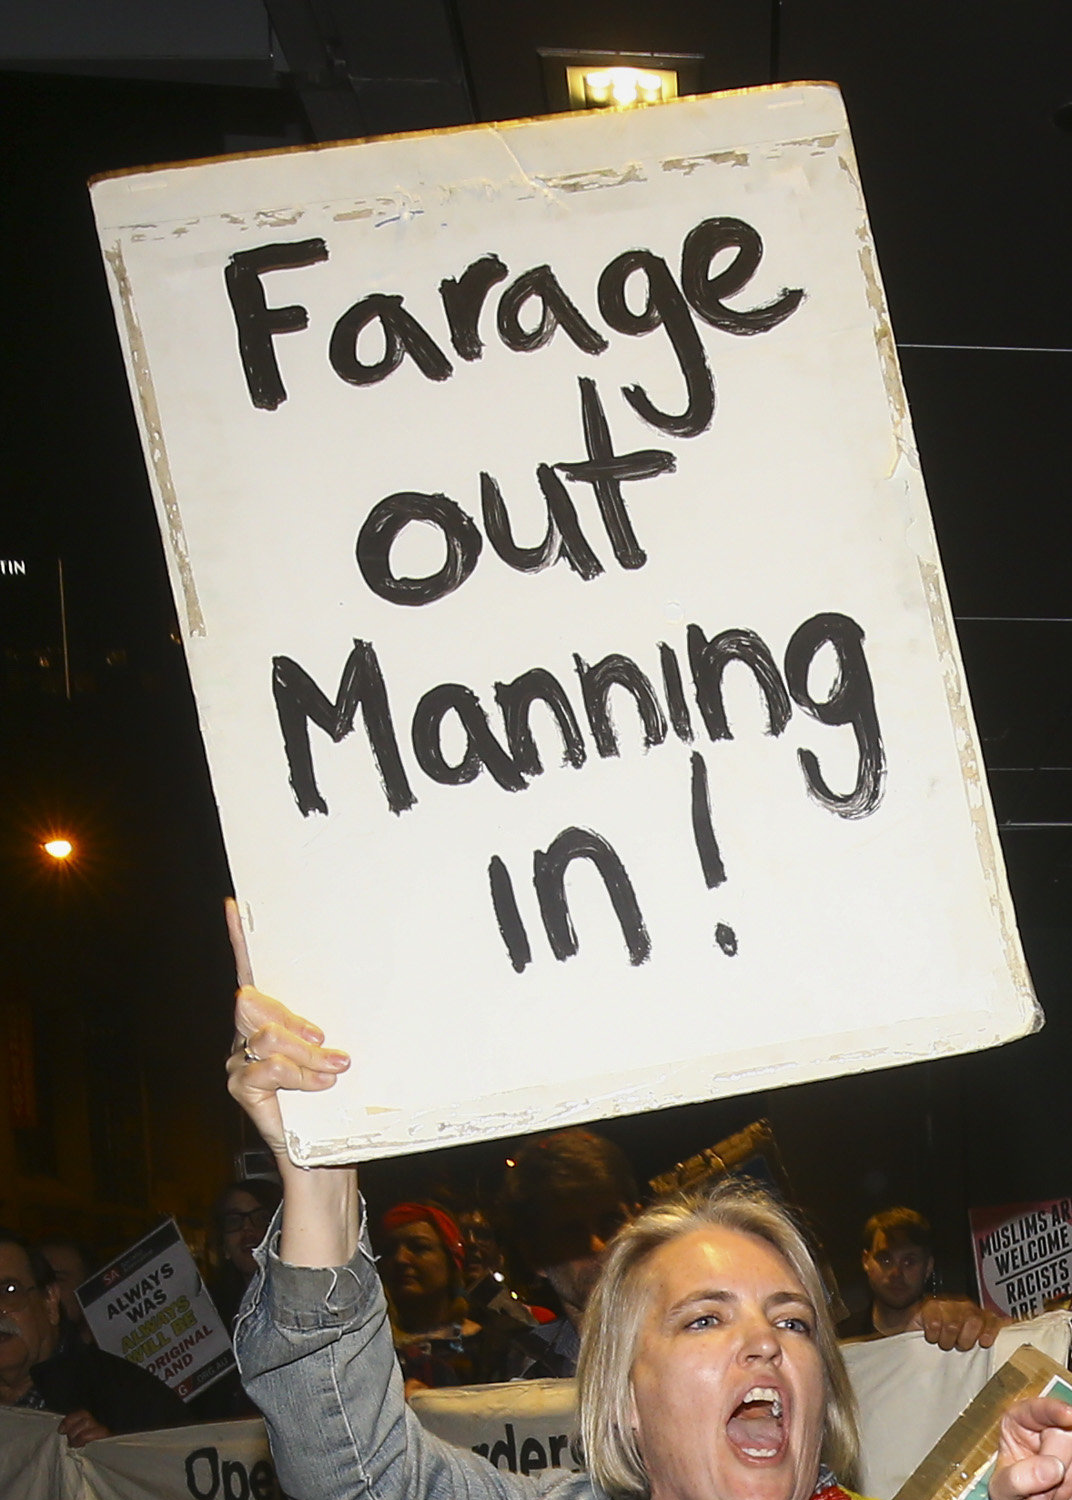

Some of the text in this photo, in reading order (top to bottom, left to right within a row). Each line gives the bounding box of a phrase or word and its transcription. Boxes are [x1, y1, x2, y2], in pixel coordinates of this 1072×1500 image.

[223, 216, 804, 439] Farage
[354, 377, 677, 607] out
[270, 611, 886, 819] Manning
[979, 1210, 1047, 1259] MUSLIMS
[995, 1226, 1069, 1277] WELCOME
[106, 1263, 174, 1320] ALWAYS
[126, 1289, 167, 1324] WAS
[1006, 1258, 1069, 1305] RACISTS
[121, 1295, 191, 1352] ALWAYS
[125, 1310, 198, 1364] WILL BE
